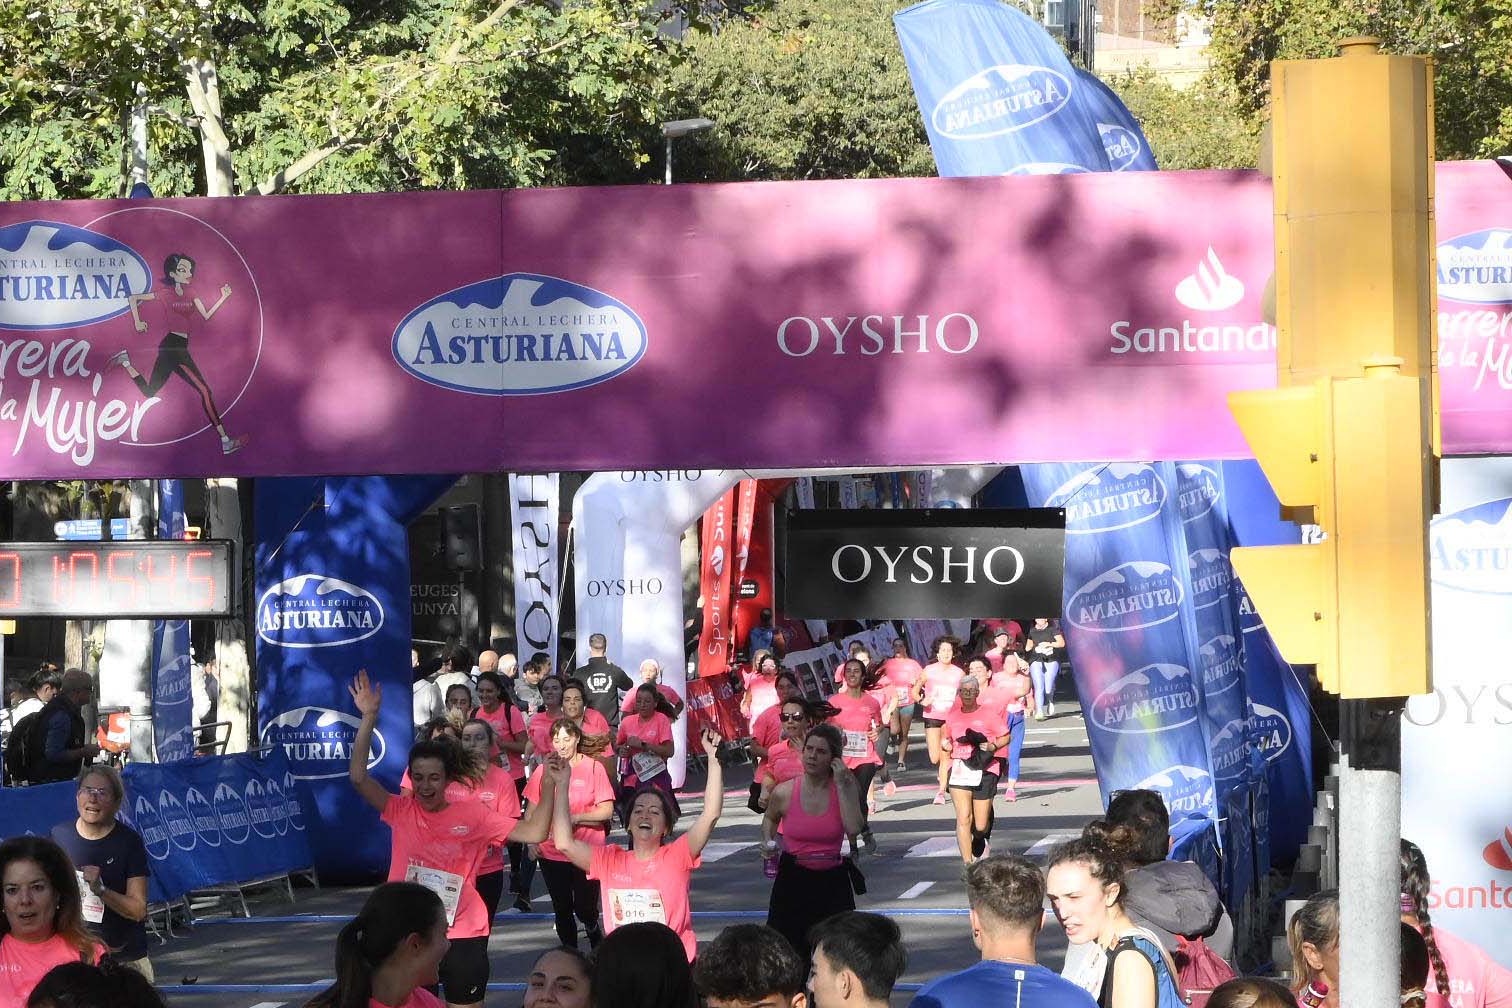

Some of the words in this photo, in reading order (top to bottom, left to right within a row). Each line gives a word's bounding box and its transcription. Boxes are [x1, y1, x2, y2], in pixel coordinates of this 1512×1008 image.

[54, 256, 127, 269] LECHERA
[451, 315, 529, 330] CENTRAL
[538, 313, 619, 328] LECHERA
[776, 312, 980, 357] OYSHO
[412, 320, 627, 366] ASTURIANA
[1110, 320, 1276, 354] Santand
[13, 373, 161, 467] Mujer
[831, 544, 1025, 586] OYSHO
[409, 584, 459, 597] EUGES
[587, 577, 663, 597] OYSHO
[261, 604, 375, 632] ASTURIANA
[413, 602, 459, 616] UNYA
[709, 580, 725, 655] Sports
[594, 677, 607, 687] BP
[1404, 684, 1512, 727] OYS
[625, 910, 645, 918] 016
